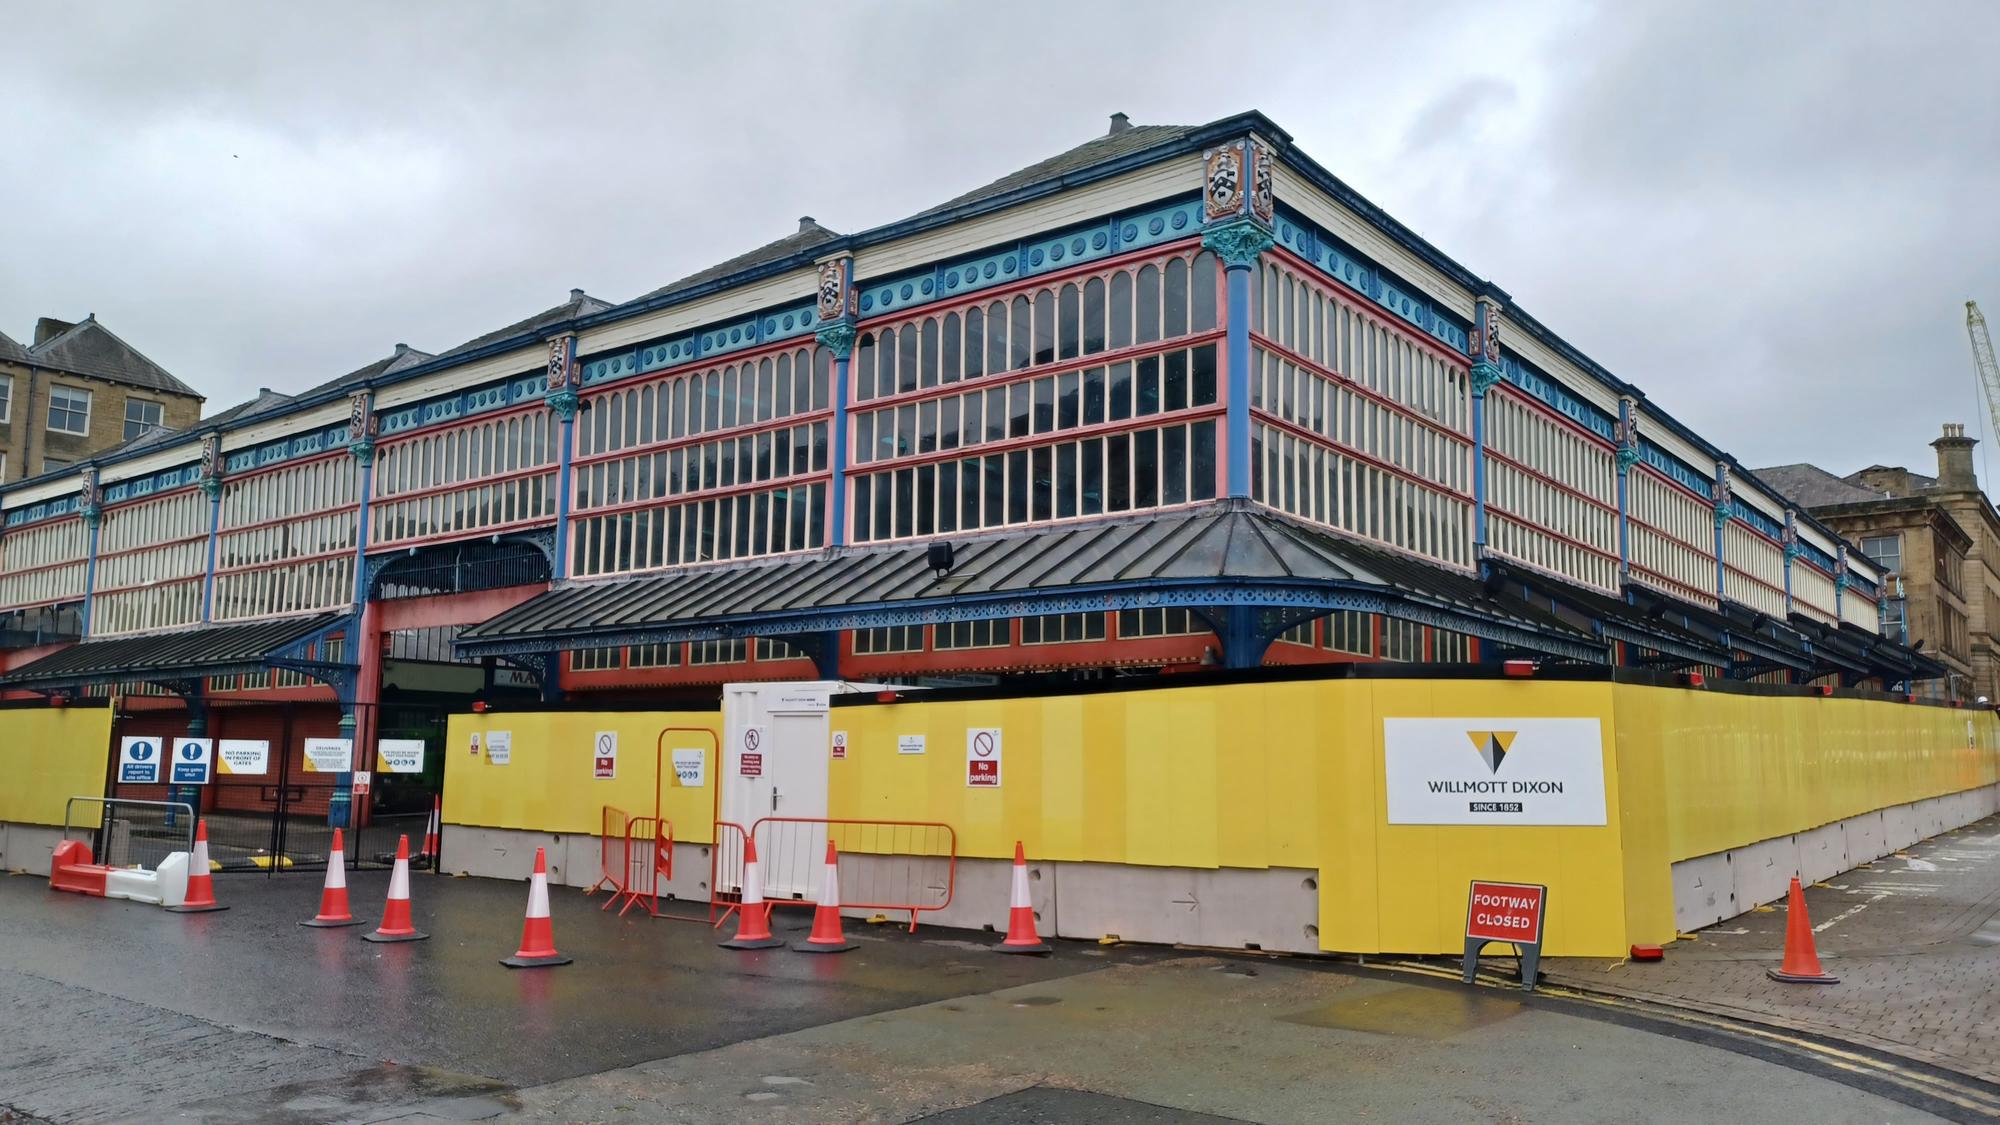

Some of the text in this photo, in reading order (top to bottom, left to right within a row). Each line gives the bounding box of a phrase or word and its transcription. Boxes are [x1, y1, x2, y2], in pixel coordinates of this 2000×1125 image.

[978, 762, 989, 770] No
[596, 768, 613, 776] parking
[970, 774, 996, 783] parking
[1427, 781, 1564, 794] WILLMOTT DIXON
[1473, 803, 1519, 812] SINCE 1852
[1474, 894, 1536, 909] FOOTWAY
[1477, 913, 1530, 928] CLOSED
